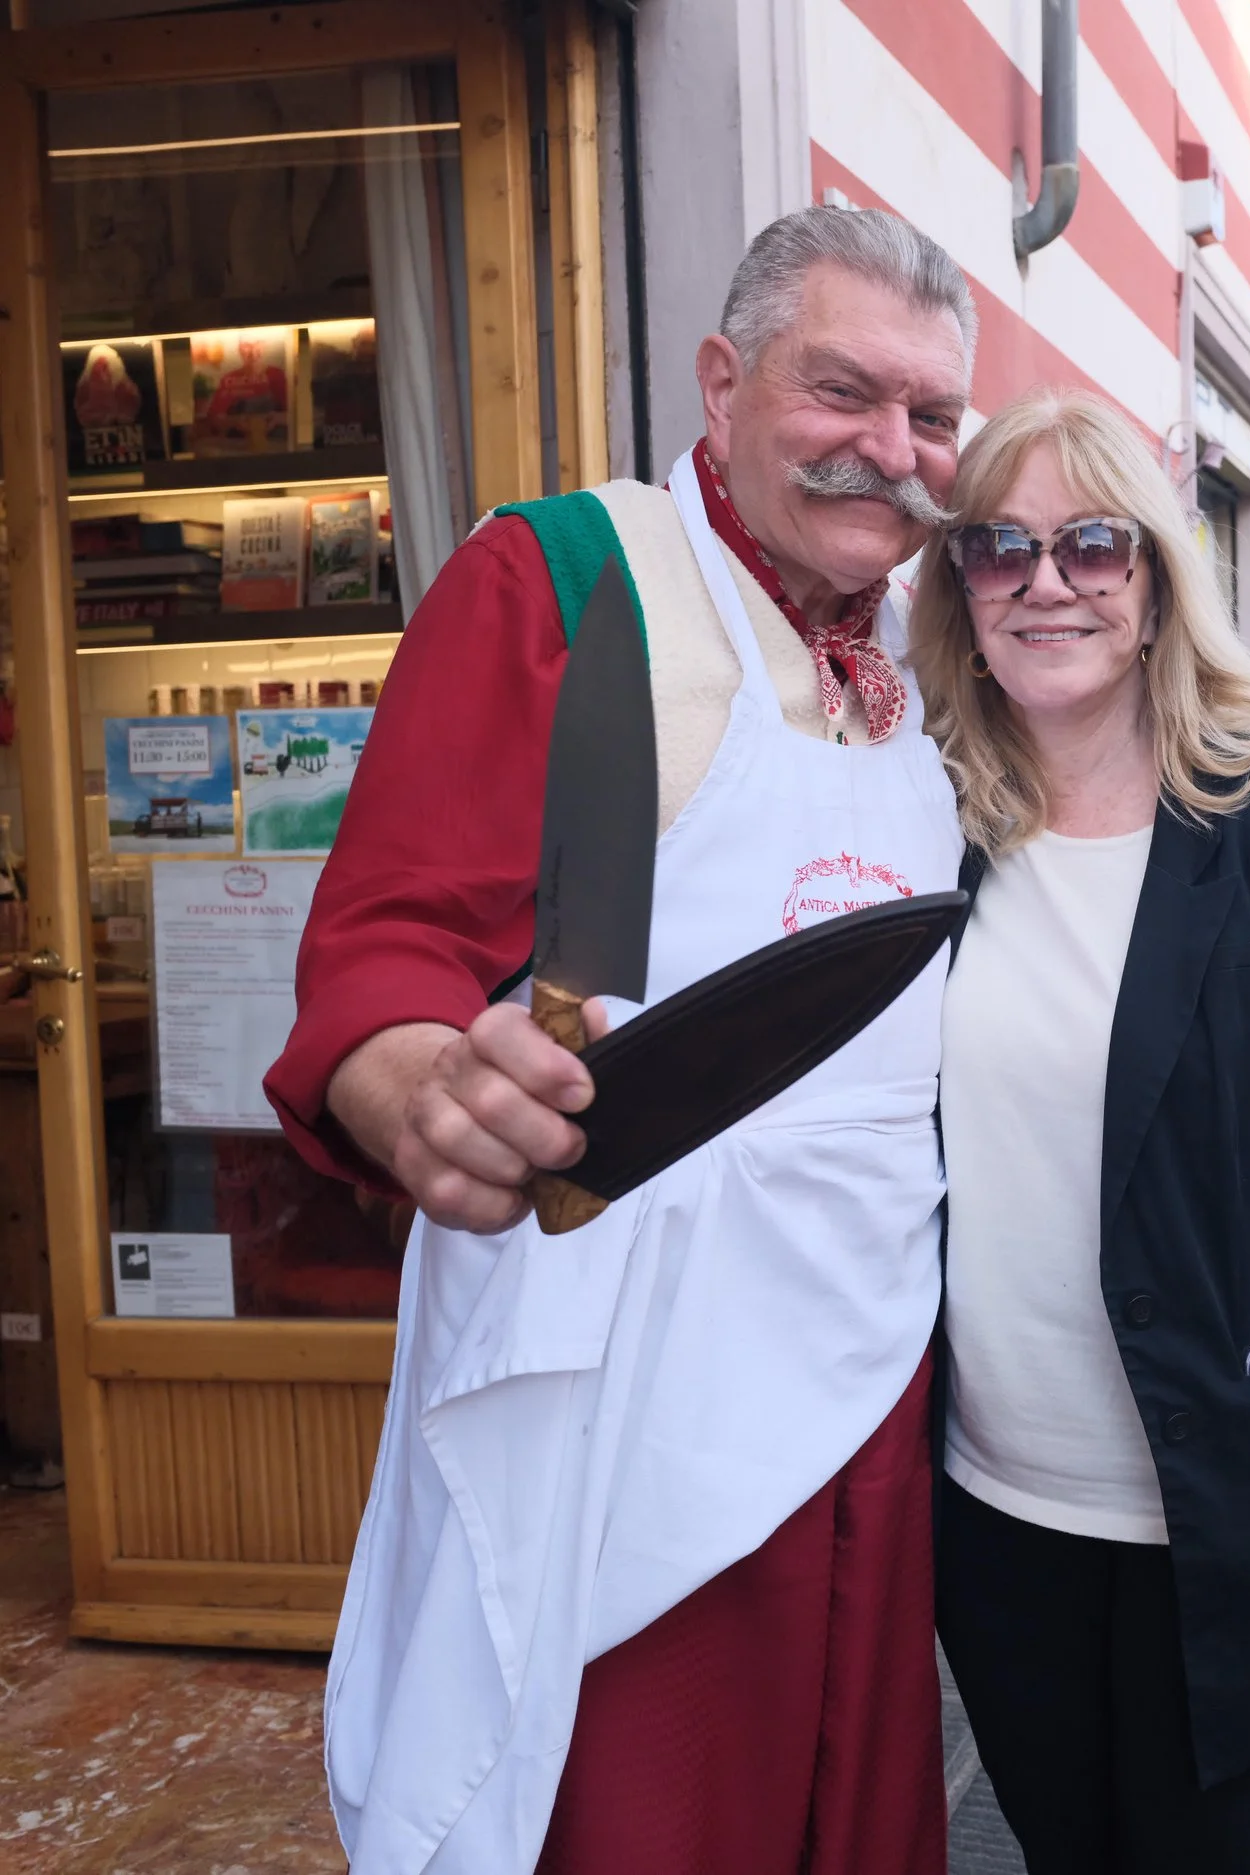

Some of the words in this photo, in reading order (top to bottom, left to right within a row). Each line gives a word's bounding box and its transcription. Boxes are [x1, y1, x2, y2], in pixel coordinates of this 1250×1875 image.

[186, 905, 247, 916] CECCHINI
[251, 906, 294, 917] PANINI
[799, 898, 841, 913] ANTICA
